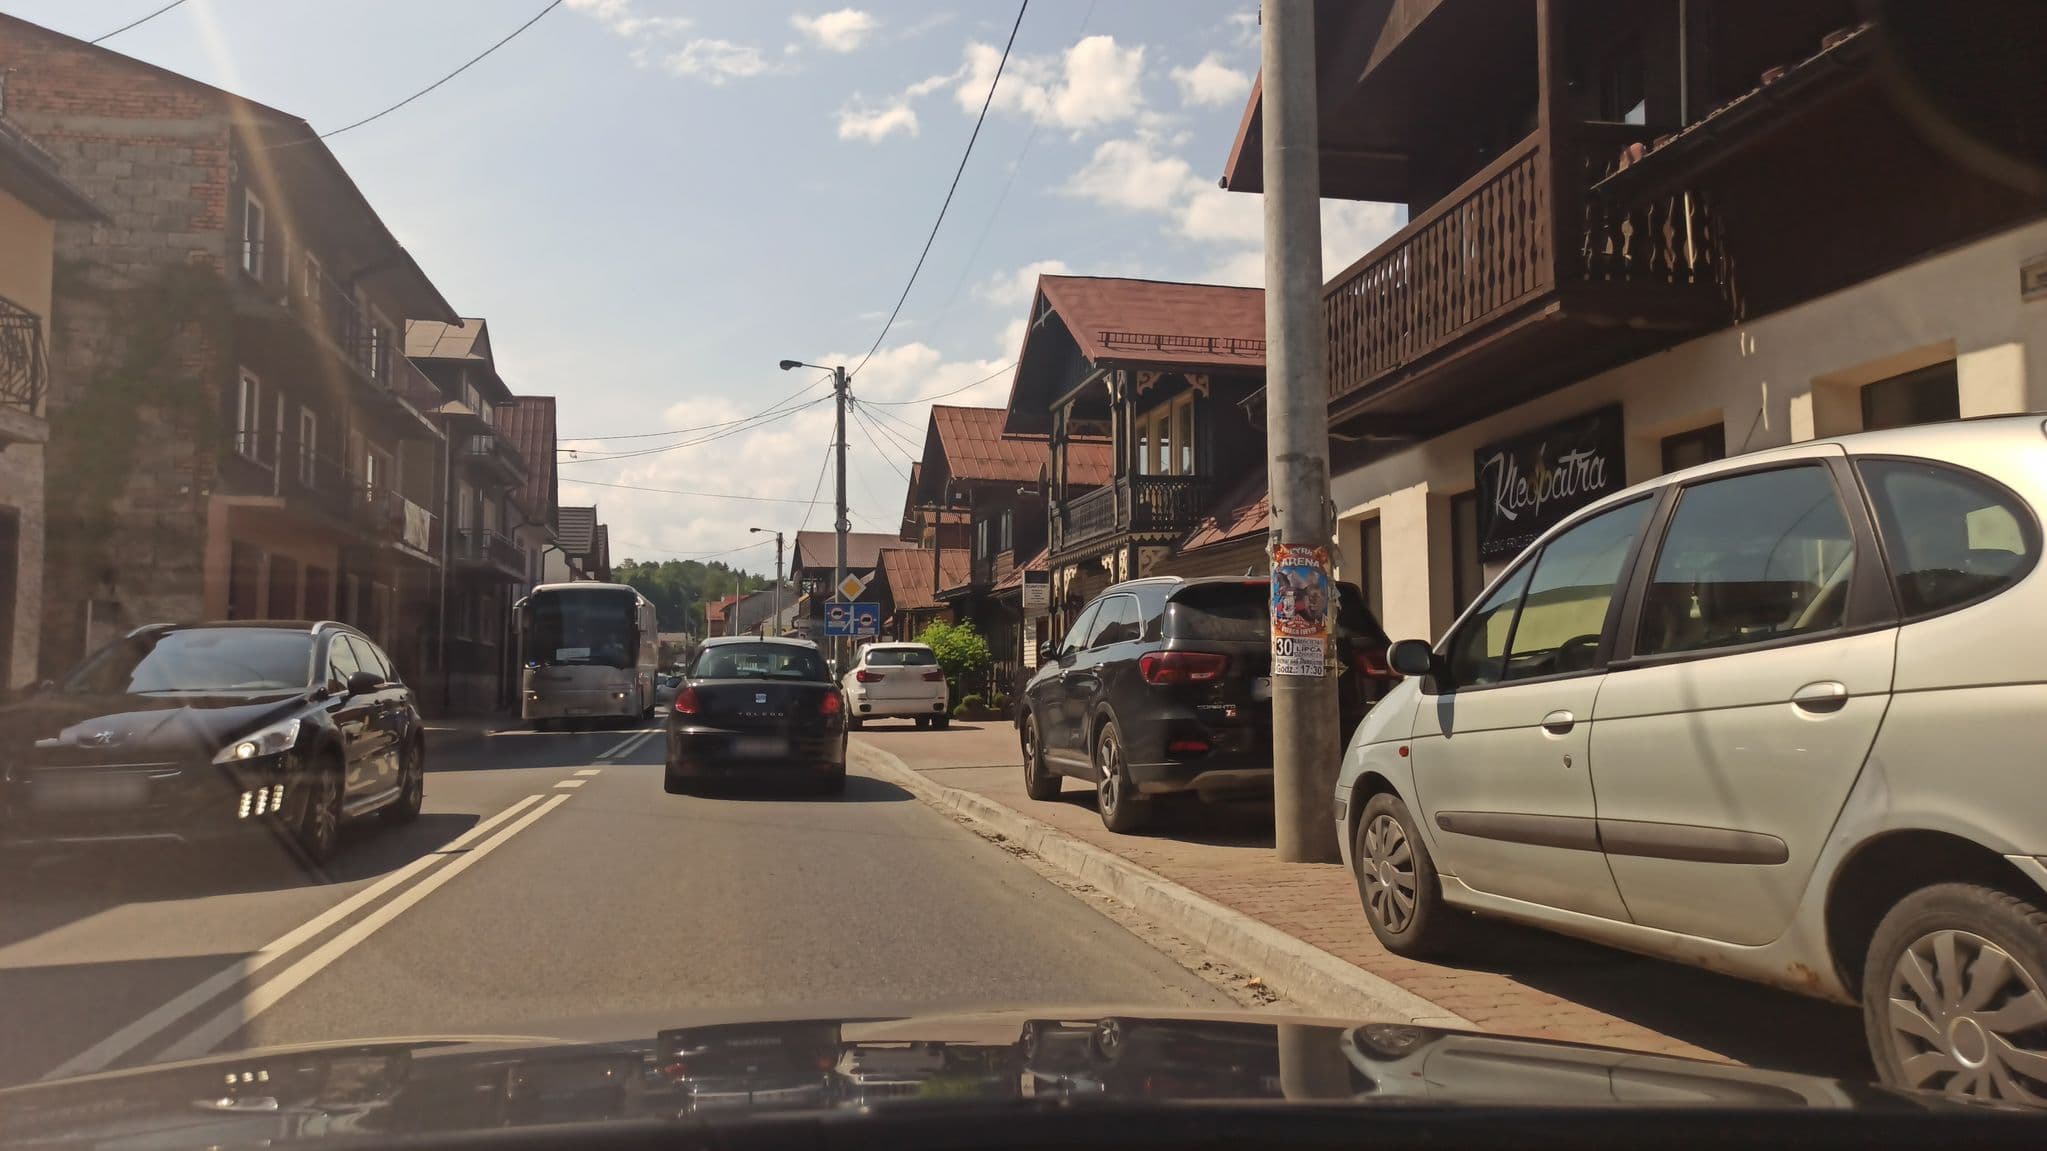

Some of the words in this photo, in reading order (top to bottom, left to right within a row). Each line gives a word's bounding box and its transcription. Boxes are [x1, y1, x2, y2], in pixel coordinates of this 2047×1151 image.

[1482, 445, 1606, 520] Kleopatra
[1281, 557, 1320, 567] ARENA
[1276, 638, 1293, 656] 30
[1301, 664, 1323, 675] 17:30
